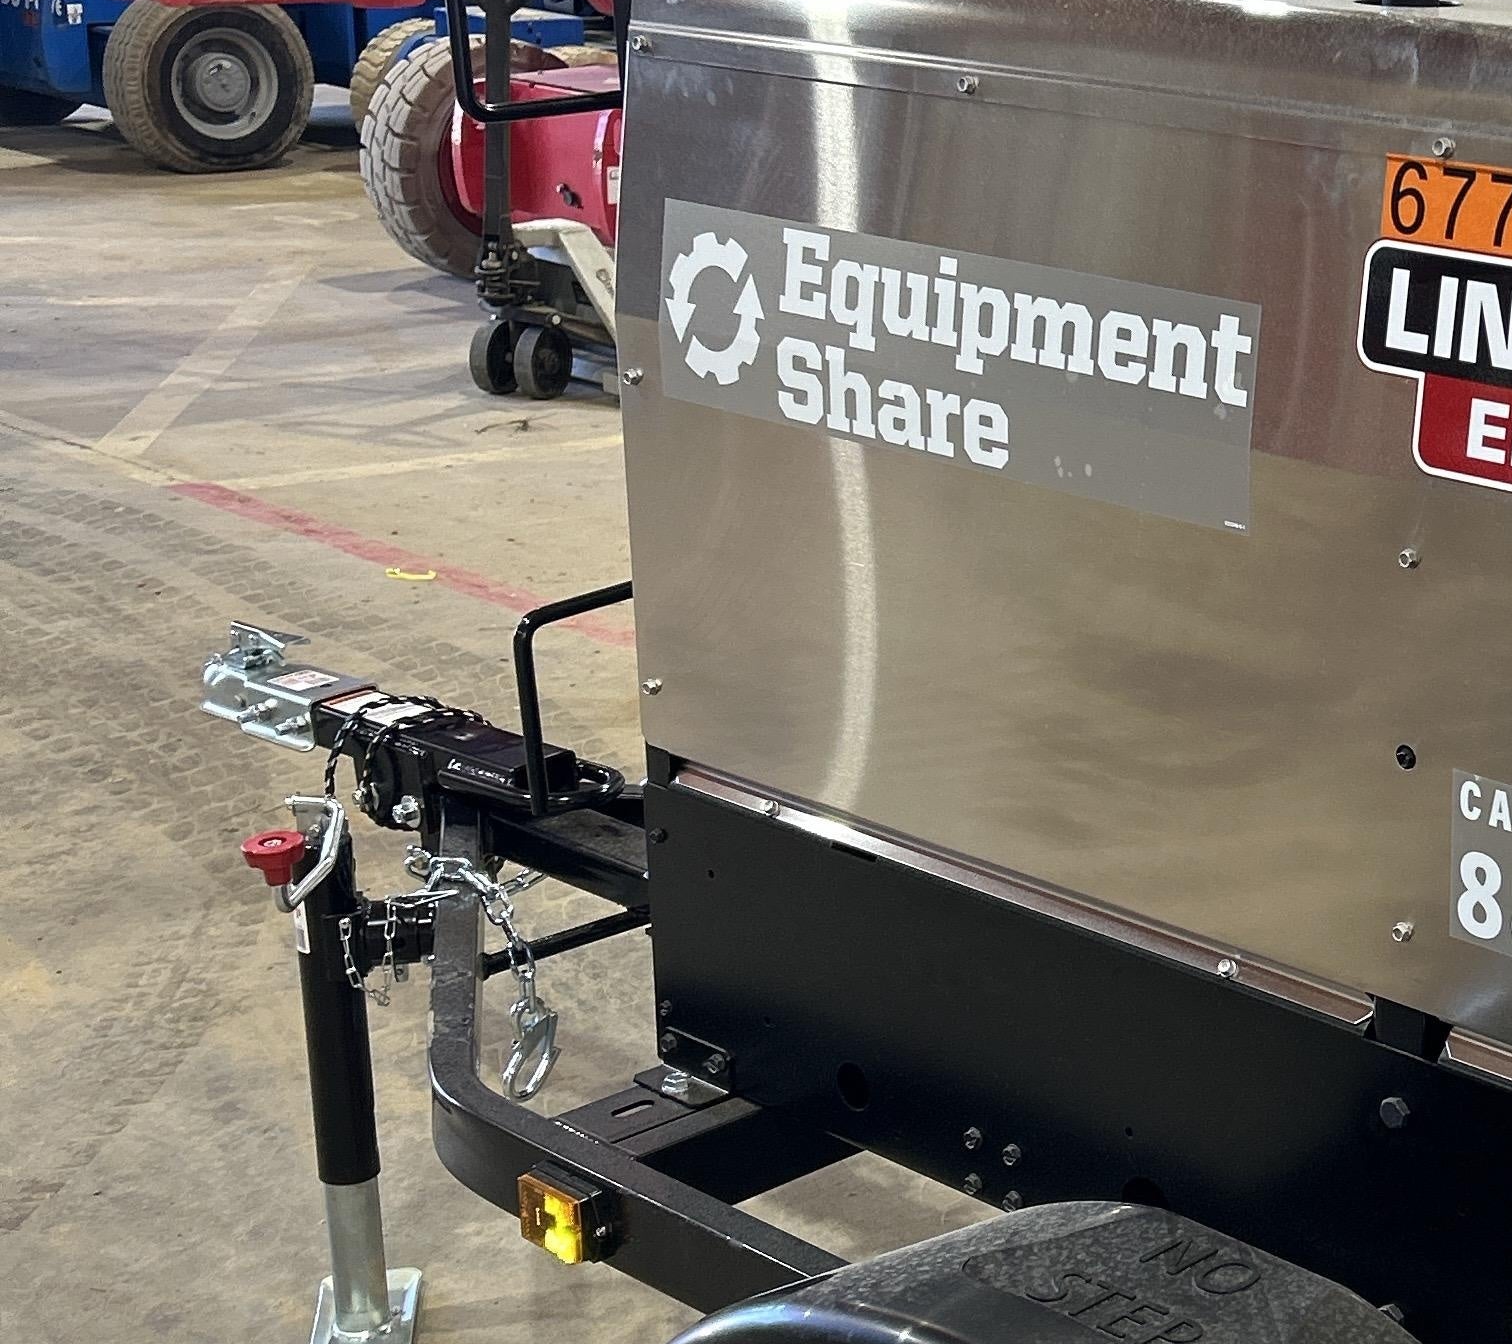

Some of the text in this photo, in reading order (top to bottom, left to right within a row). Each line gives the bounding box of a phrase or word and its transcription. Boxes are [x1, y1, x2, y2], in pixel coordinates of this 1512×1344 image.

[779, 227, 1253, 408] Equipment
[776, 336, 1010, 470] Share
[1139, 1239, 1261, 1295] NO
